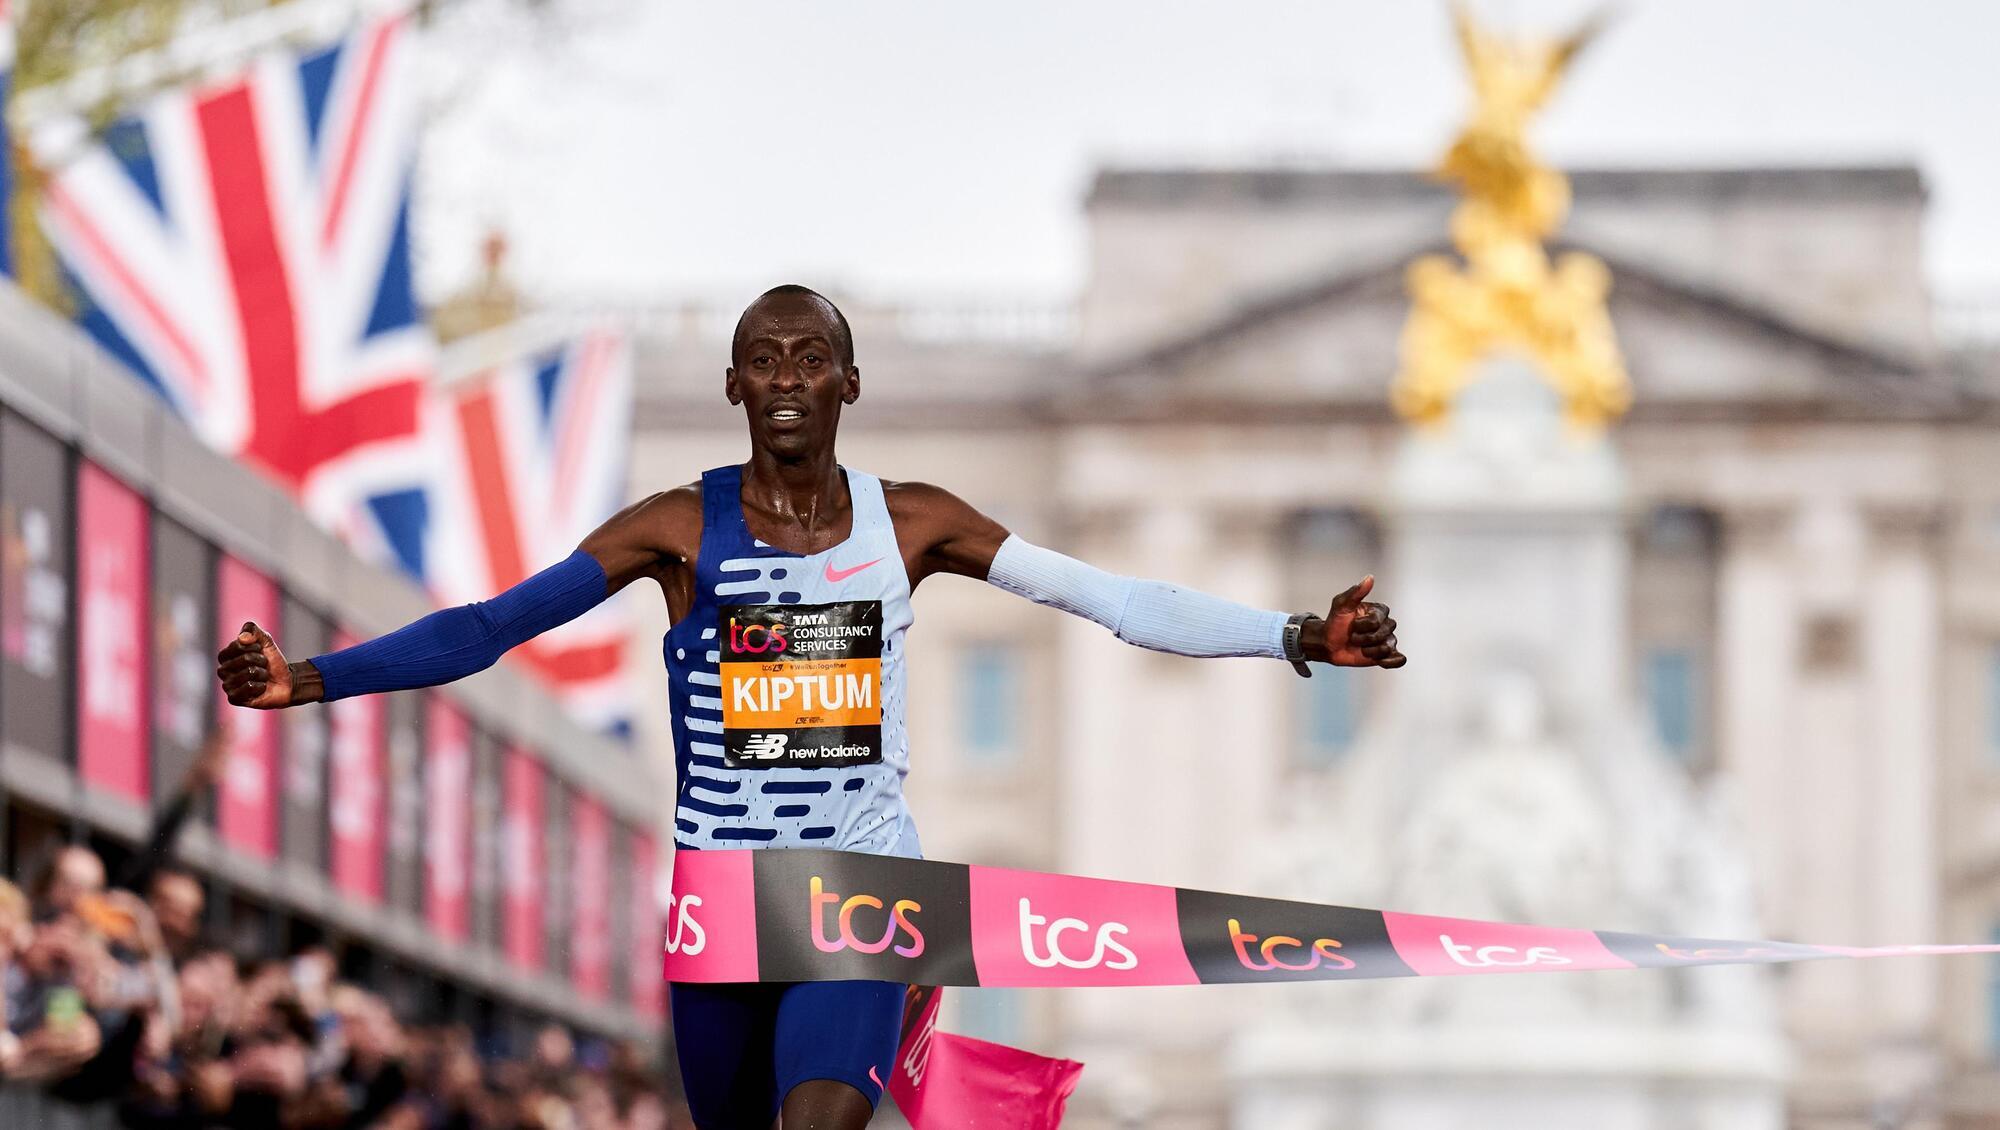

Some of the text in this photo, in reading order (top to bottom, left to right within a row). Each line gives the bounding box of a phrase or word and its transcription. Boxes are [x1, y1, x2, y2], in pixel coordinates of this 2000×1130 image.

[793, 614, 828, 625] TATA
[730, 617, 787, 653] tcs
[793, 626, 873, 639] CONSULTANCY
[794, 639, 847, 652] SERVICES
[732, 673, 872, 712] KIPTUM
[789, 744, 870, 759] new balance
[665, 893, 706, 956] cs
[810, 876, 925, 958] tcs
[1019, 897, 1138, 970] tcs
[1227, 918, 1356, 971] tcs
[1439, 934, 1572, 967] tcs
